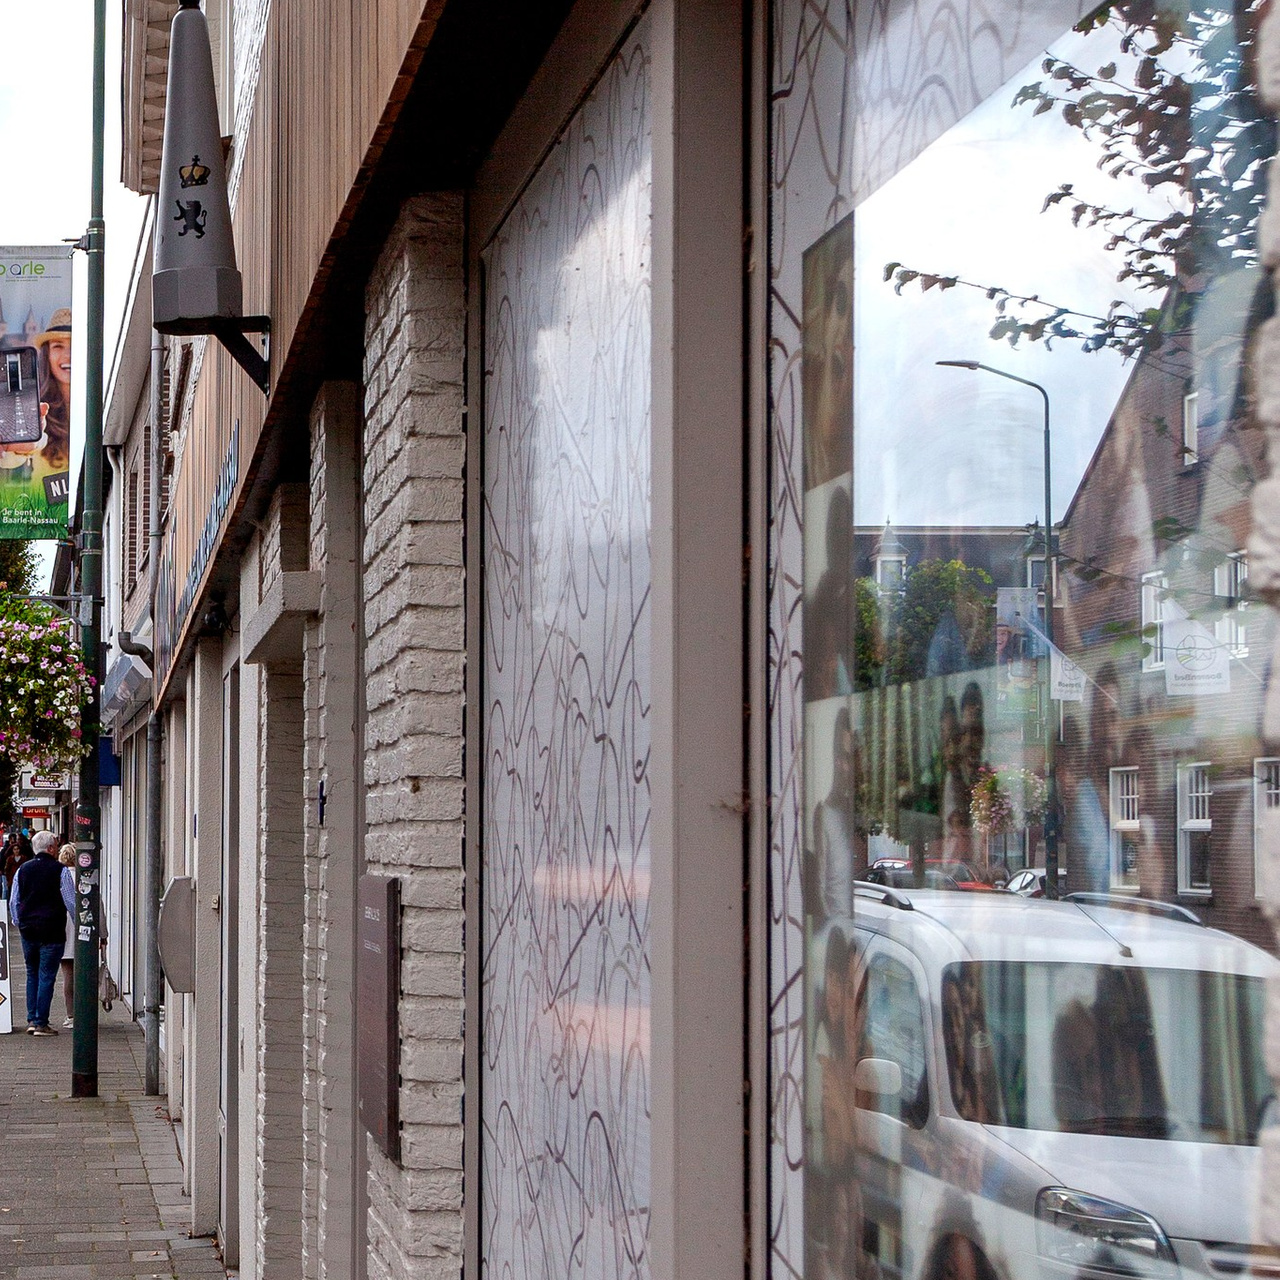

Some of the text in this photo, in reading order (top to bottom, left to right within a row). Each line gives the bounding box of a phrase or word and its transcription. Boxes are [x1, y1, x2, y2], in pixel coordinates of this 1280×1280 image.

[50, 479, 69, 497] NL
[2, 508, 42, 516] Je bent in
